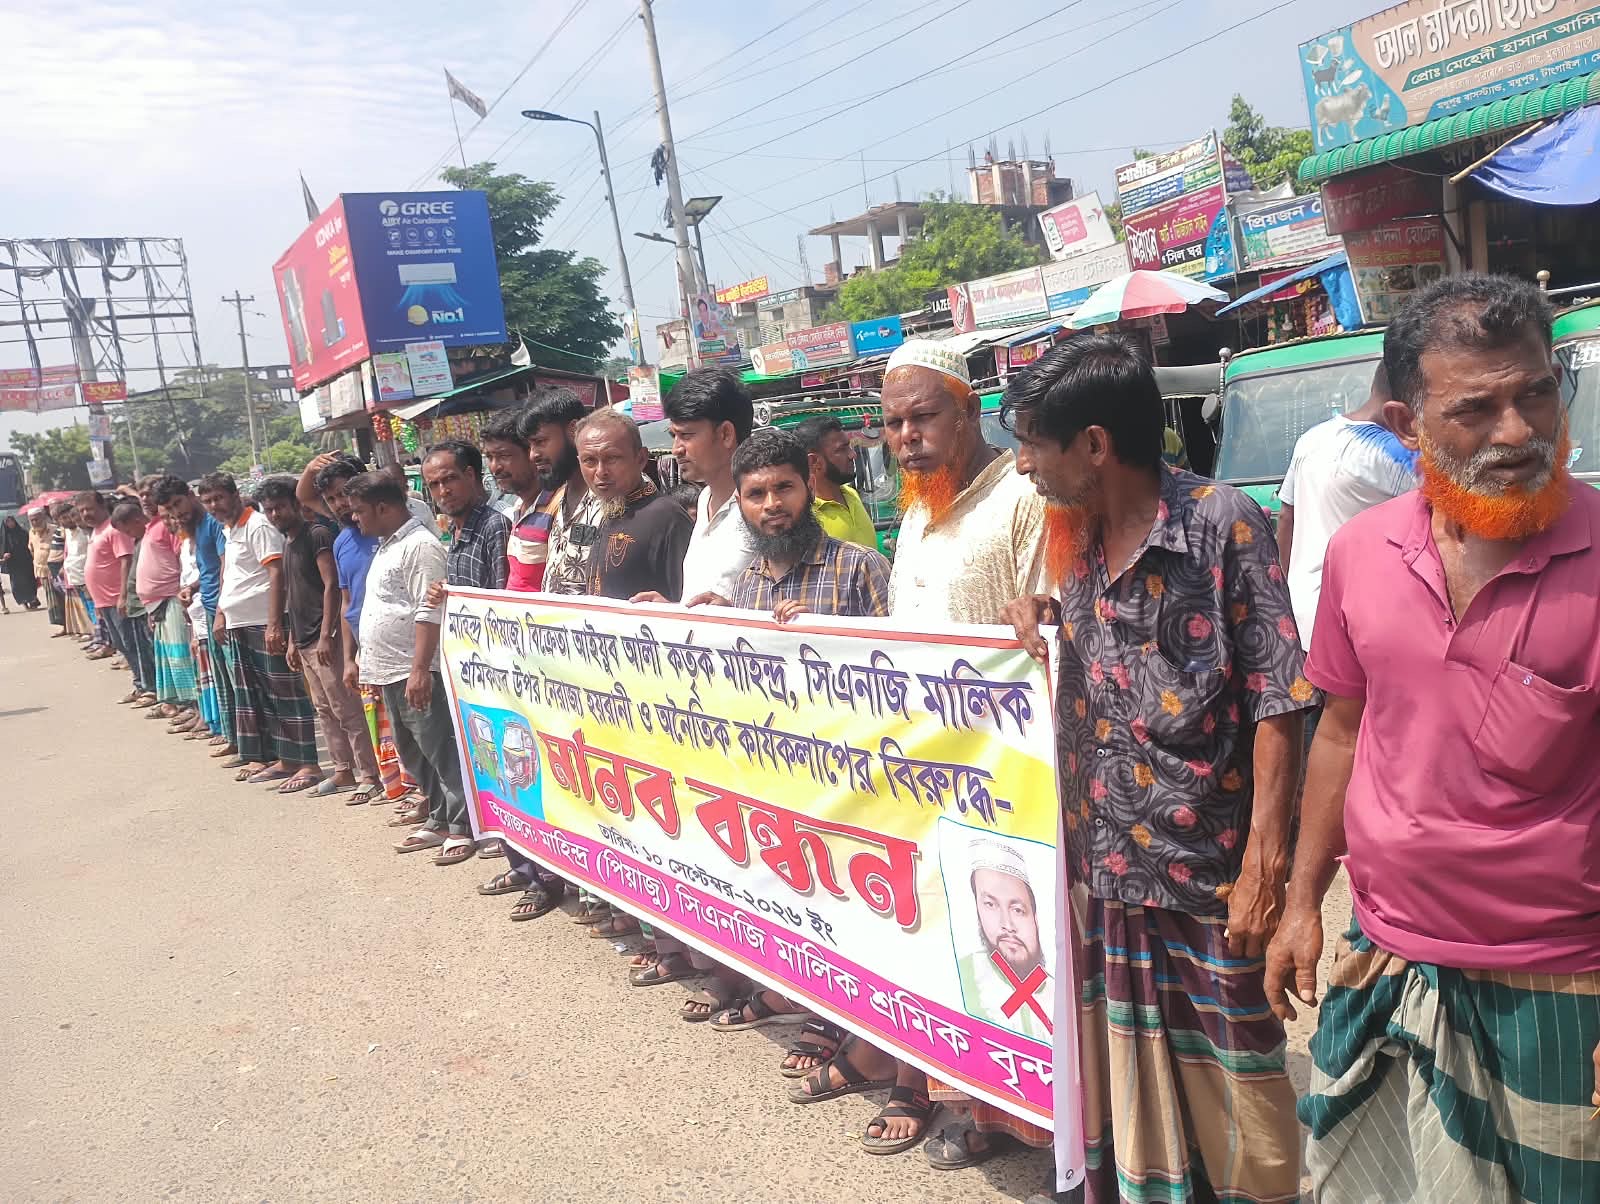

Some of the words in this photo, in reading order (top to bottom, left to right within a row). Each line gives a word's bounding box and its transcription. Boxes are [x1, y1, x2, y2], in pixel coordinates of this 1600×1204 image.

[1372, 17, 1422, 69] আল
[1446, 46, 1497, 73] মেহেদী
[1500, 29, 1550, 53] হাসান
[1552, 12, 1600, 33] আসি
[401, 202, 455, 215] GREE
[620, 624, 663, 680] আলী
[662, 629, 715, 699] কর্তৃক
[799, 643, 913, 723] সিএনজি
[916, 658, 1036, 738] মালিক
[512, 660, 542, 704] উপর
[637, 701, 654, 733] ও
[654, 693, 732, 751] অনৈতিক
[733, 711, 880, 799] কার্যকলাপের
[537, 728, 681, 839] মানব
[685, 776, 923, 934] বন্ধন
[595, 848, 671, 912] (পিয়াজু)
[674, 882, 768, 957] সিএনজি
[772, 942, 862, 1003] মালিক
[867, 982, 973, 1059] শ্রমিক
[806, 906, 838, 946] ইং
